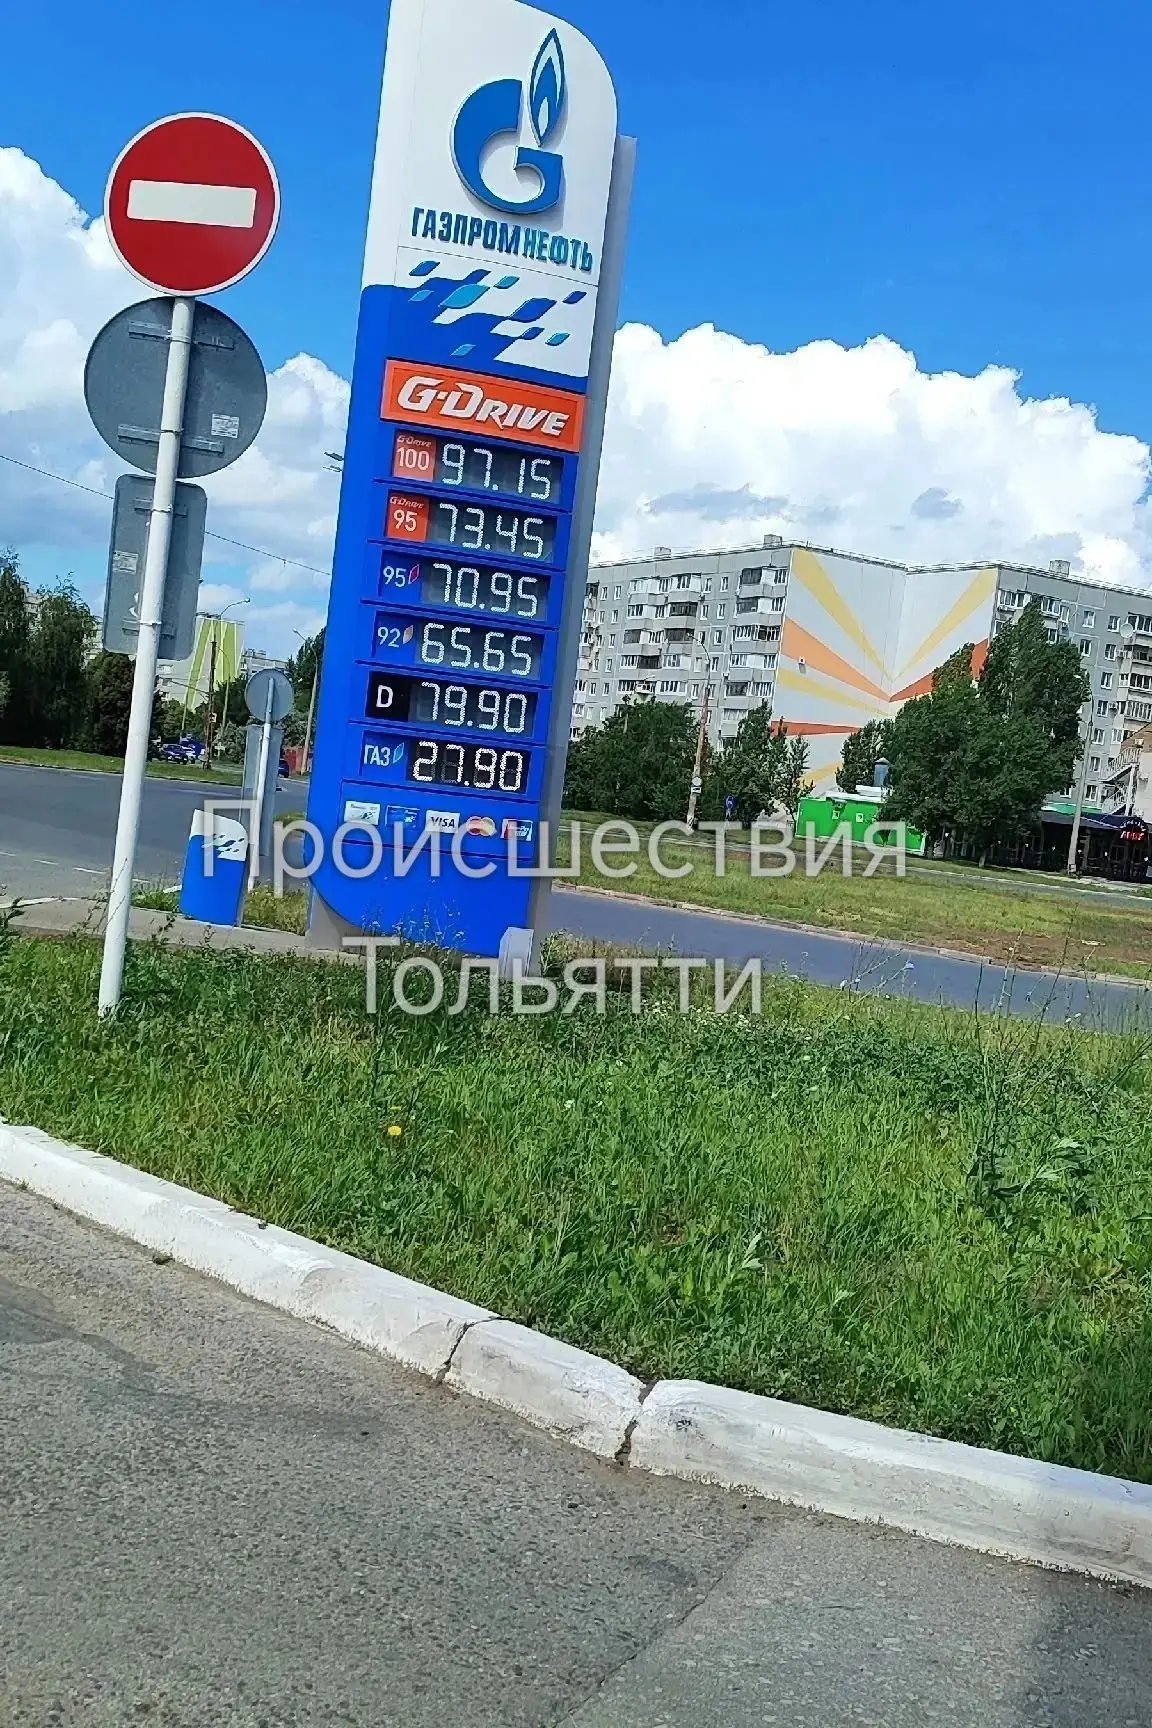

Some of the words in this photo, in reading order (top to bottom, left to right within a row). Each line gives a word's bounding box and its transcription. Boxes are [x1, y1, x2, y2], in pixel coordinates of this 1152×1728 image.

[396, 447, 430, 471] 100
[442, 443, 551, 500] 97.15
[393, 509, 418, 532] 95
[439, 503, 544, 559] 73.45
[383, 565, 407, 588] 95
[433, 563, 538, 618] 70.95
[377, 627, 400, 648] 92
[421, 622, 532, 675] 65.65
[376, 685, 393, 708] D
[421, 681, 527, 733] 79.90
[363, 745, 391, 766] ГАЗ
[413, 741, 523, 791] 27.90
[431, 816, 455, 828] VISA
